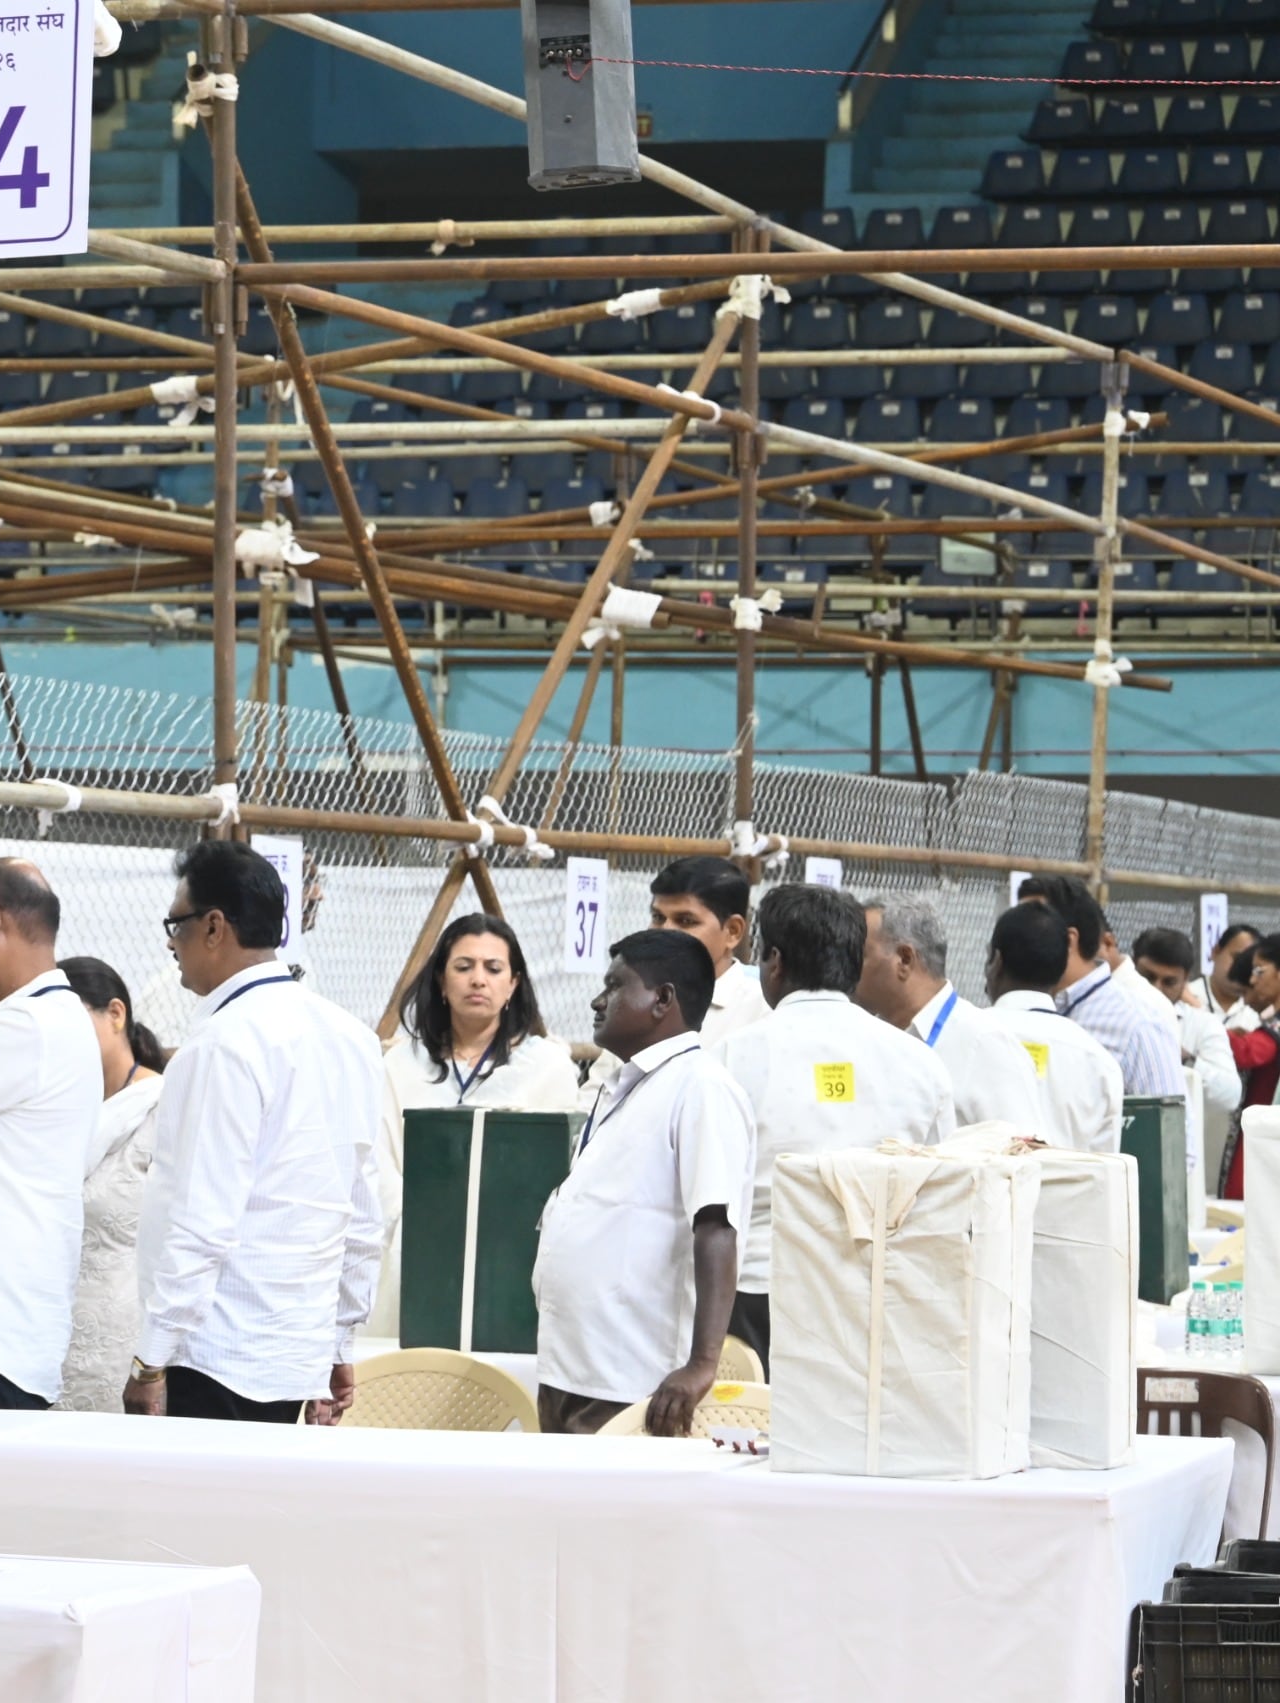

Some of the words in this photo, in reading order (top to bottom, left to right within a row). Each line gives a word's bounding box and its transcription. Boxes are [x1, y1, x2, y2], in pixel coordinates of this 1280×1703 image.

[36, 7, 64, 31] संघ
[575, 900, 598, 957] 37
[824, 1082, 845, 1098] 39
